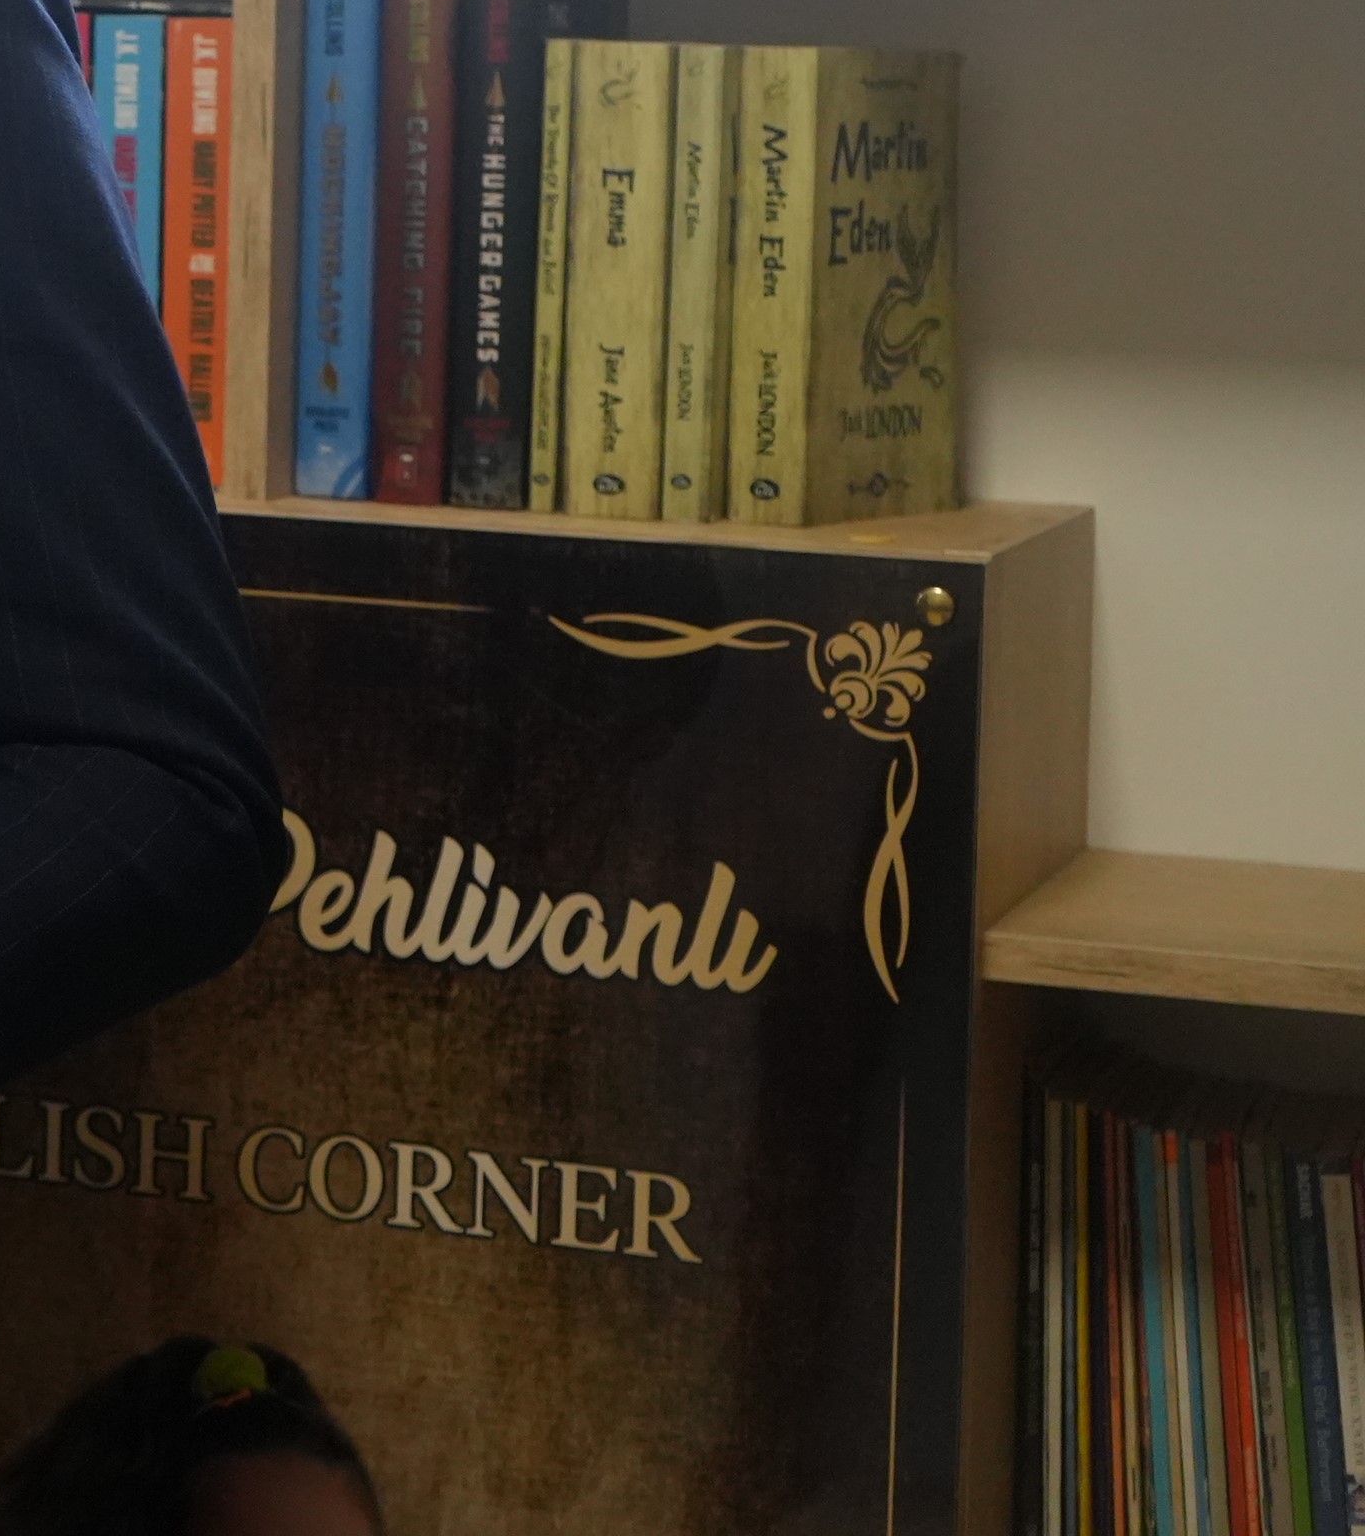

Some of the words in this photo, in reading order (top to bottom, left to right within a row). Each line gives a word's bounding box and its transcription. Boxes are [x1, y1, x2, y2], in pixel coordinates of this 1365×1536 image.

[487, 114, 506, 147] THE
[831, 121, 928, 184] Martin
[402, 116, 429, 269] CATCHING
[479, 153, 507, 267] HUNGER
[603, 168, 635, 247] Emma
[762, 124, 788, 222] Martin
[760, 234, 786, 297] Eden
[828, 198, 892, 266] Eden
[401, 287, 425, 356] FIRE
[476, 275, 502, 362] GAMES
[757, 384, 778, 456] LONDON
[237, 1126, 703, 1264] CORNER
